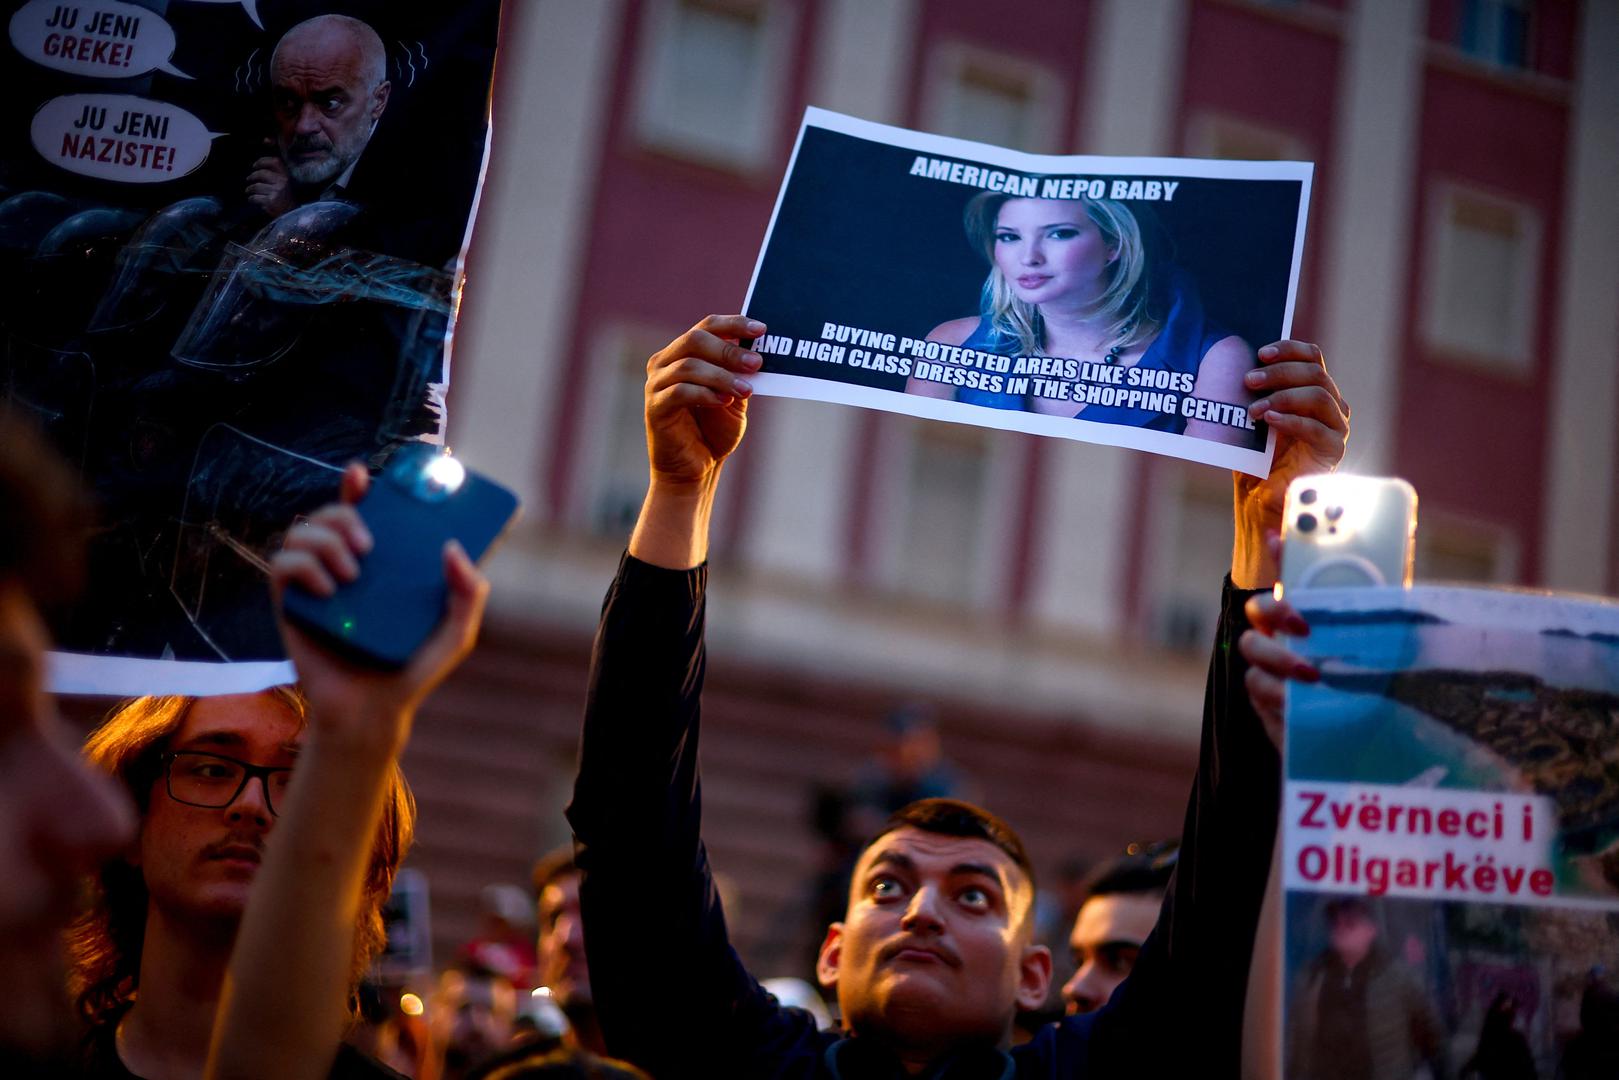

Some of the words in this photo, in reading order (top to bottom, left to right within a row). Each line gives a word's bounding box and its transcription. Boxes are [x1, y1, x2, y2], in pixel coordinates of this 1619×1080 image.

[45, 6, 79, 30] JU
[84, 11, 141, 40] JENI
[43, 33, 134, 68] GREKE!
[73, 105, 107, 131] JU
[113, 110, 169, 140] JENI
[60, 133, 176, 172] NAZISTE!
[909, 156, 1038, 198] AMERICAN
[1041, 178, 1104, 200] NEPO
[1109, 180, 1179, 201] BABY
[821, 322, 897, 352] BUYING
[898, 337, 1011, 374] PROTECTED
[1012, 357, 1079, 379] AREAS
[1080, 362, 1124, 385] LIKE
[1127, 366, 1195, 393] SHOES
[751, 334, 793, 356] AND
[795, 339, 846, 364] HIGH
[848, 349, 912, 376] CLASS
[914, 362, 1003, 394] DRESSES
[1006, 378, 1029, 395] IN
[1033, 378, 1070, 400] THE
[1072, 383, 1177, 414] SHOPPING
[1181, 397, 1256, 430] CENTRE
[1297, 792, 1505, 841] Zvërneci
[1521, 804, 1534, 842] i
[1297, 845, 1555, 896] Oligarkëve
